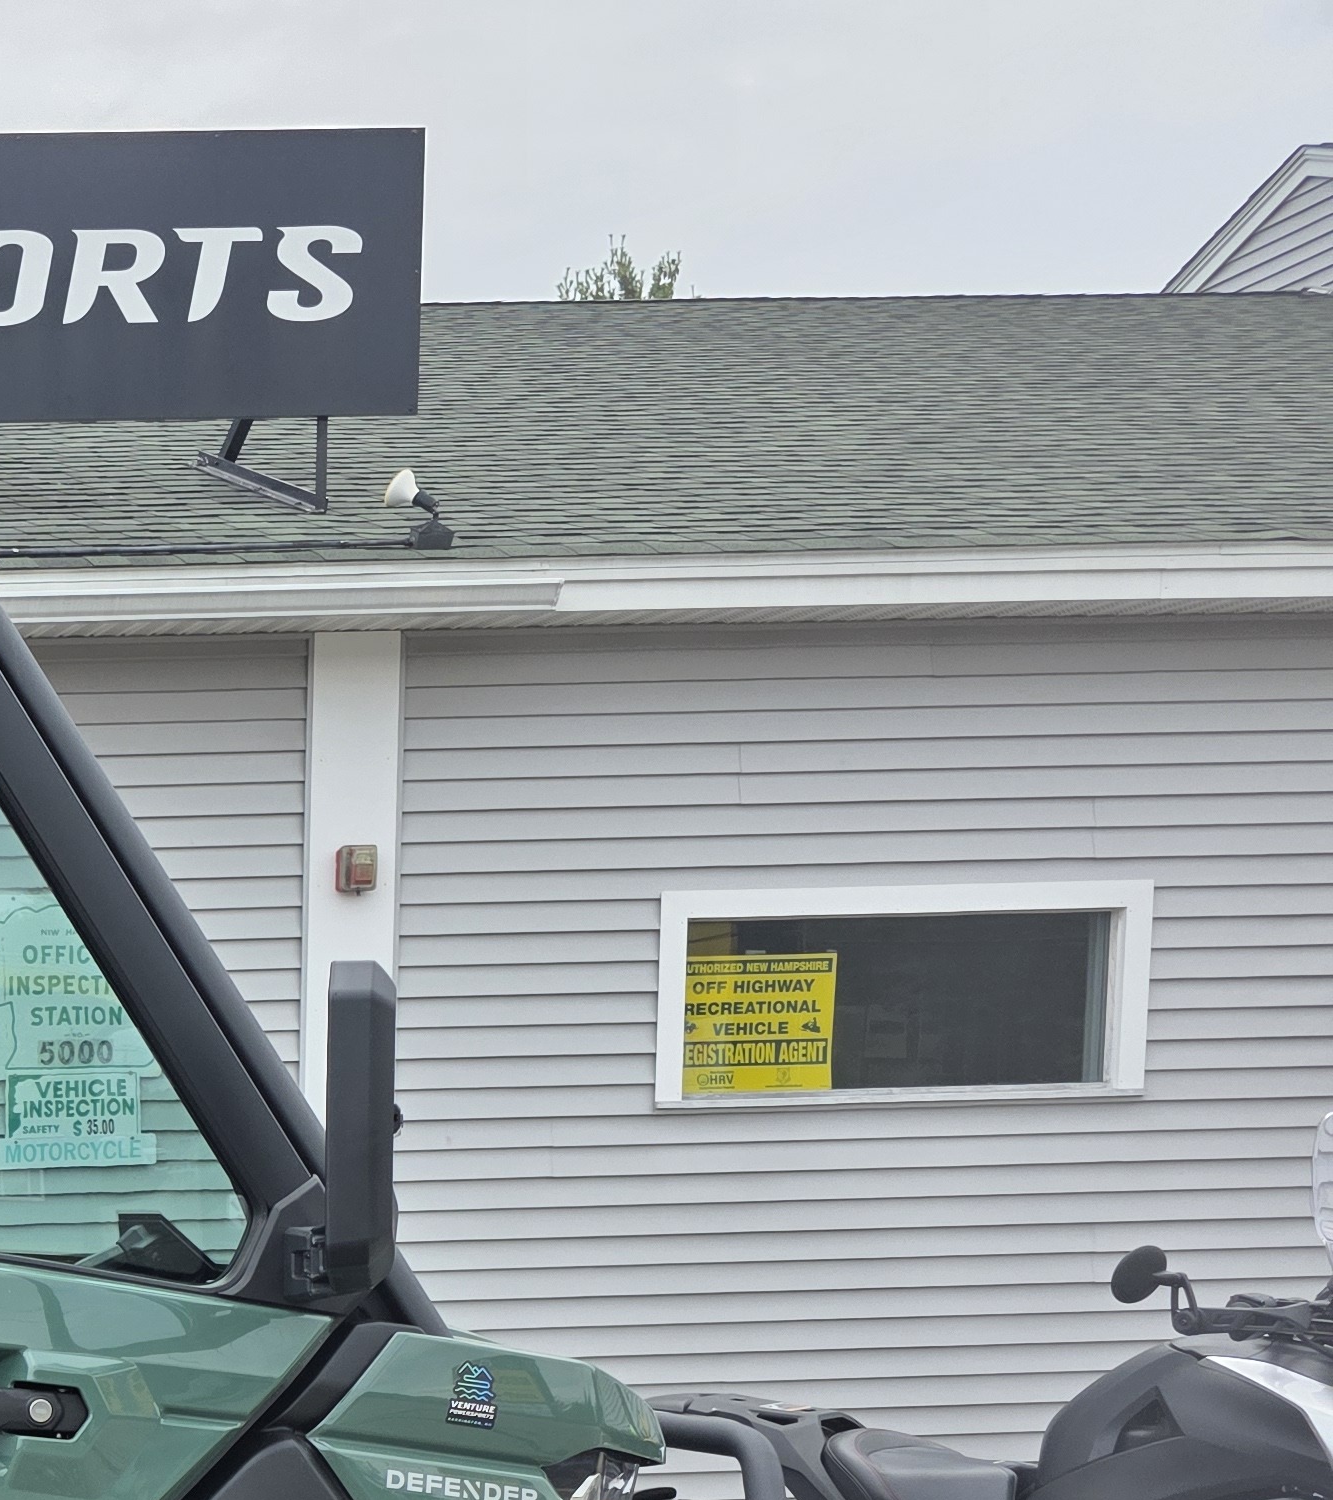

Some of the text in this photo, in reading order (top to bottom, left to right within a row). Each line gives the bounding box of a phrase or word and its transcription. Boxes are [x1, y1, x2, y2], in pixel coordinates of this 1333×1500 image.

[22, 945, 91, 964] OFFIC
[686, 961, 830, 974] UTHORIZED NEW HAMPSHIRE
[8, 974, 110, 996] INSPECTI
[692, 978, 816, 995] OFF HIGHWAY
[30, 1005, 123, 1027] STATION
[684, 1000, 821, 1016] RECREATIONAL
[713, 1021, 789, 1037] VEHICLE
[39, 1039, 114, 1066] 5000
[684, 1041, 826, 1066] EGISTRATION AGENT
[35, 1078, 127, 1099] VEHICLE
[23, 1098, 135, 1119] INSPECTION
[22, 1118, 115, 1137] SAFETY $ 35.00
[5, 1140, 142, 1164] MOTORCYCLE
[451, 1400, 496, 1414] VENTURE
